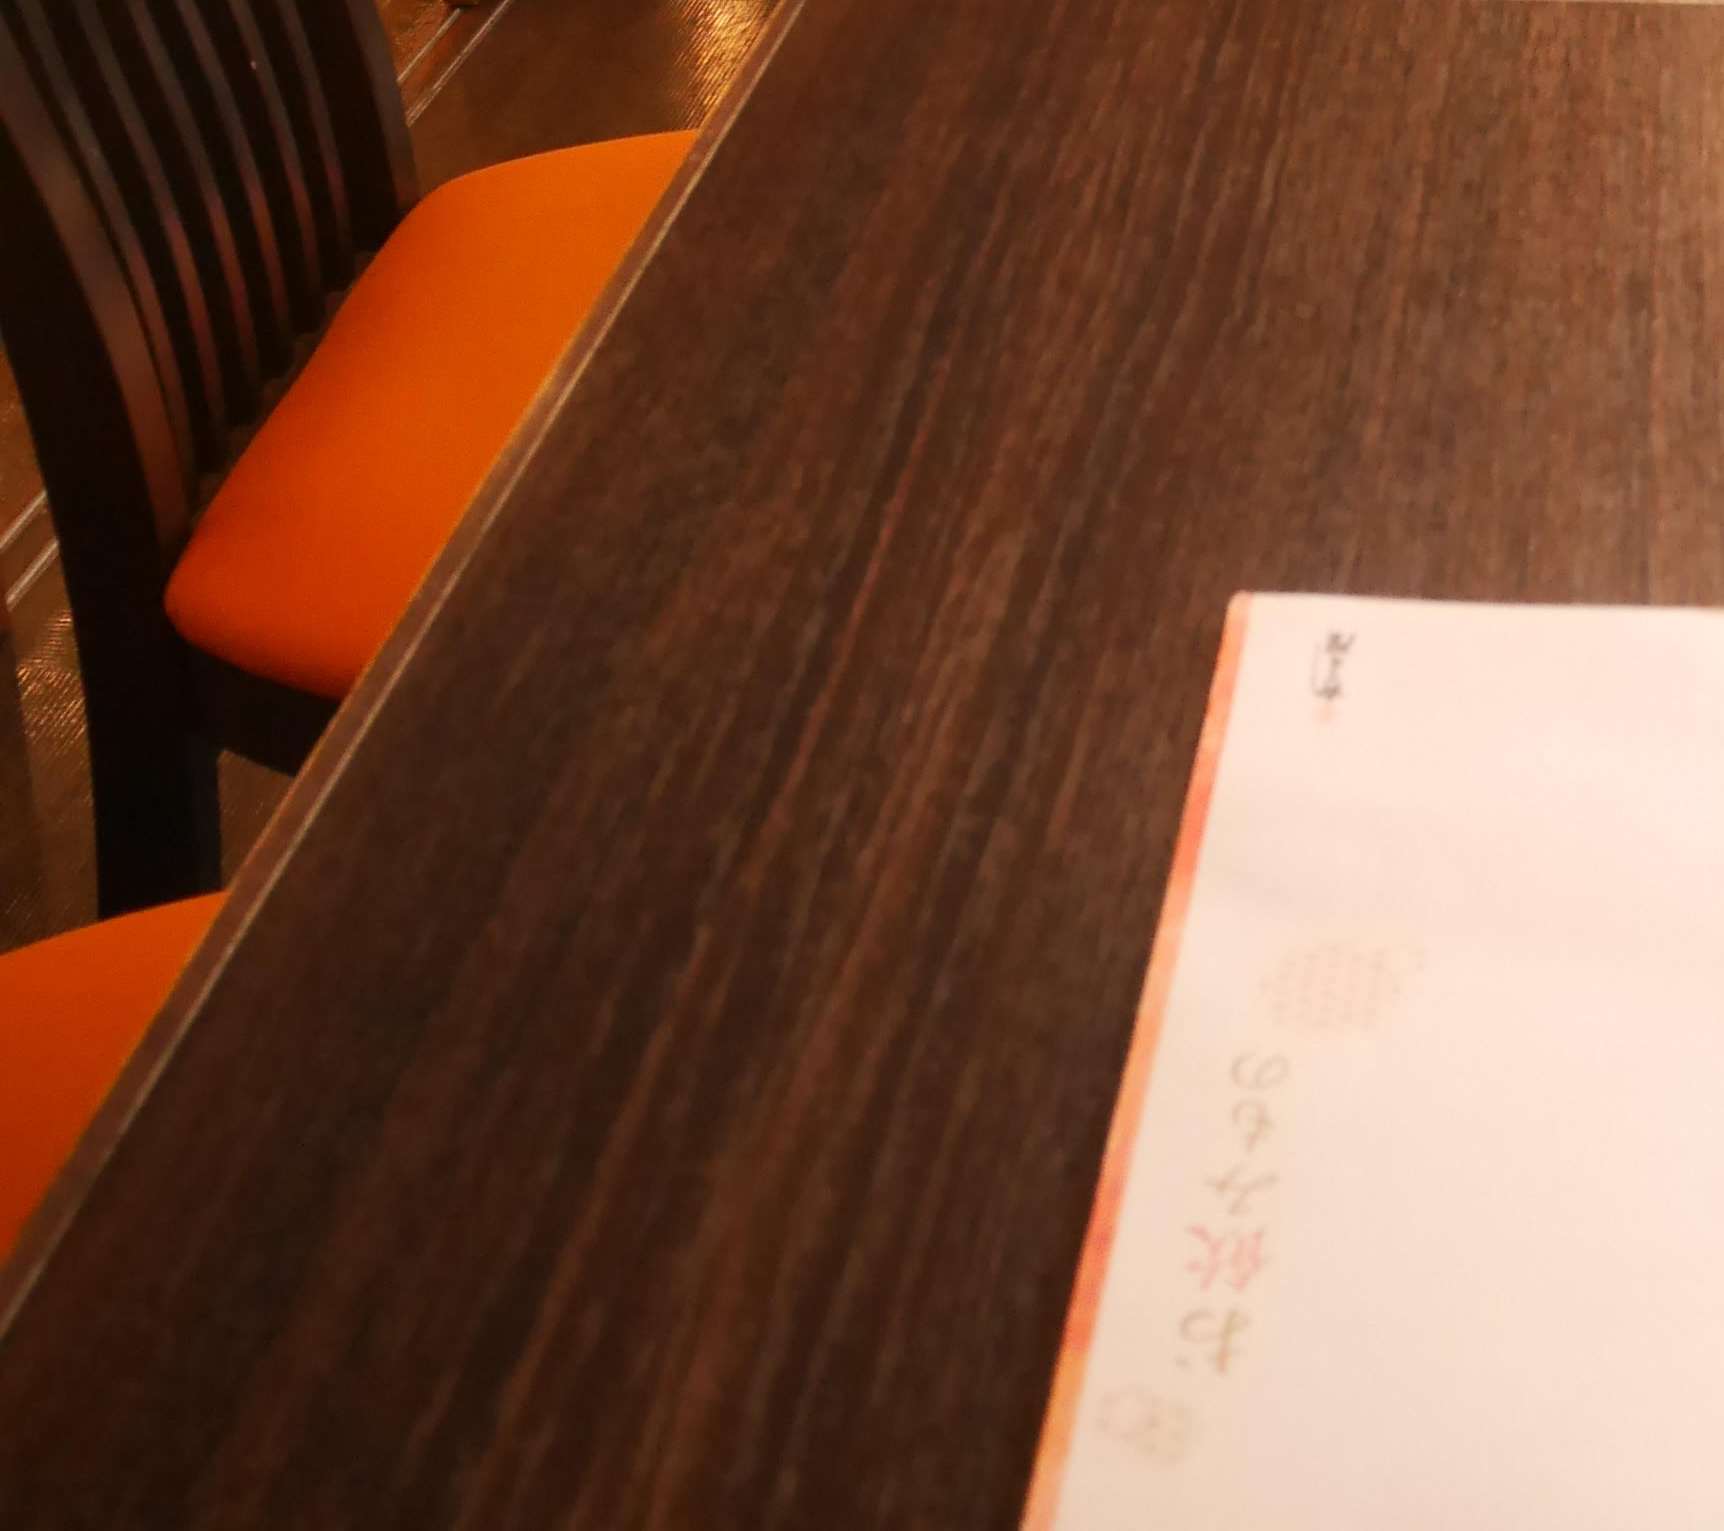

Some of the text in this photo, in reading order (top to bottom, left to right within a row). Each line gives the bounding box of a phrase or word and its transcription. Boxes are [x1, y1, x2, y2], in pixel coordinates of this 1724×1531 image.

[1171, 1046, 1292, 1381] お飲みもの
